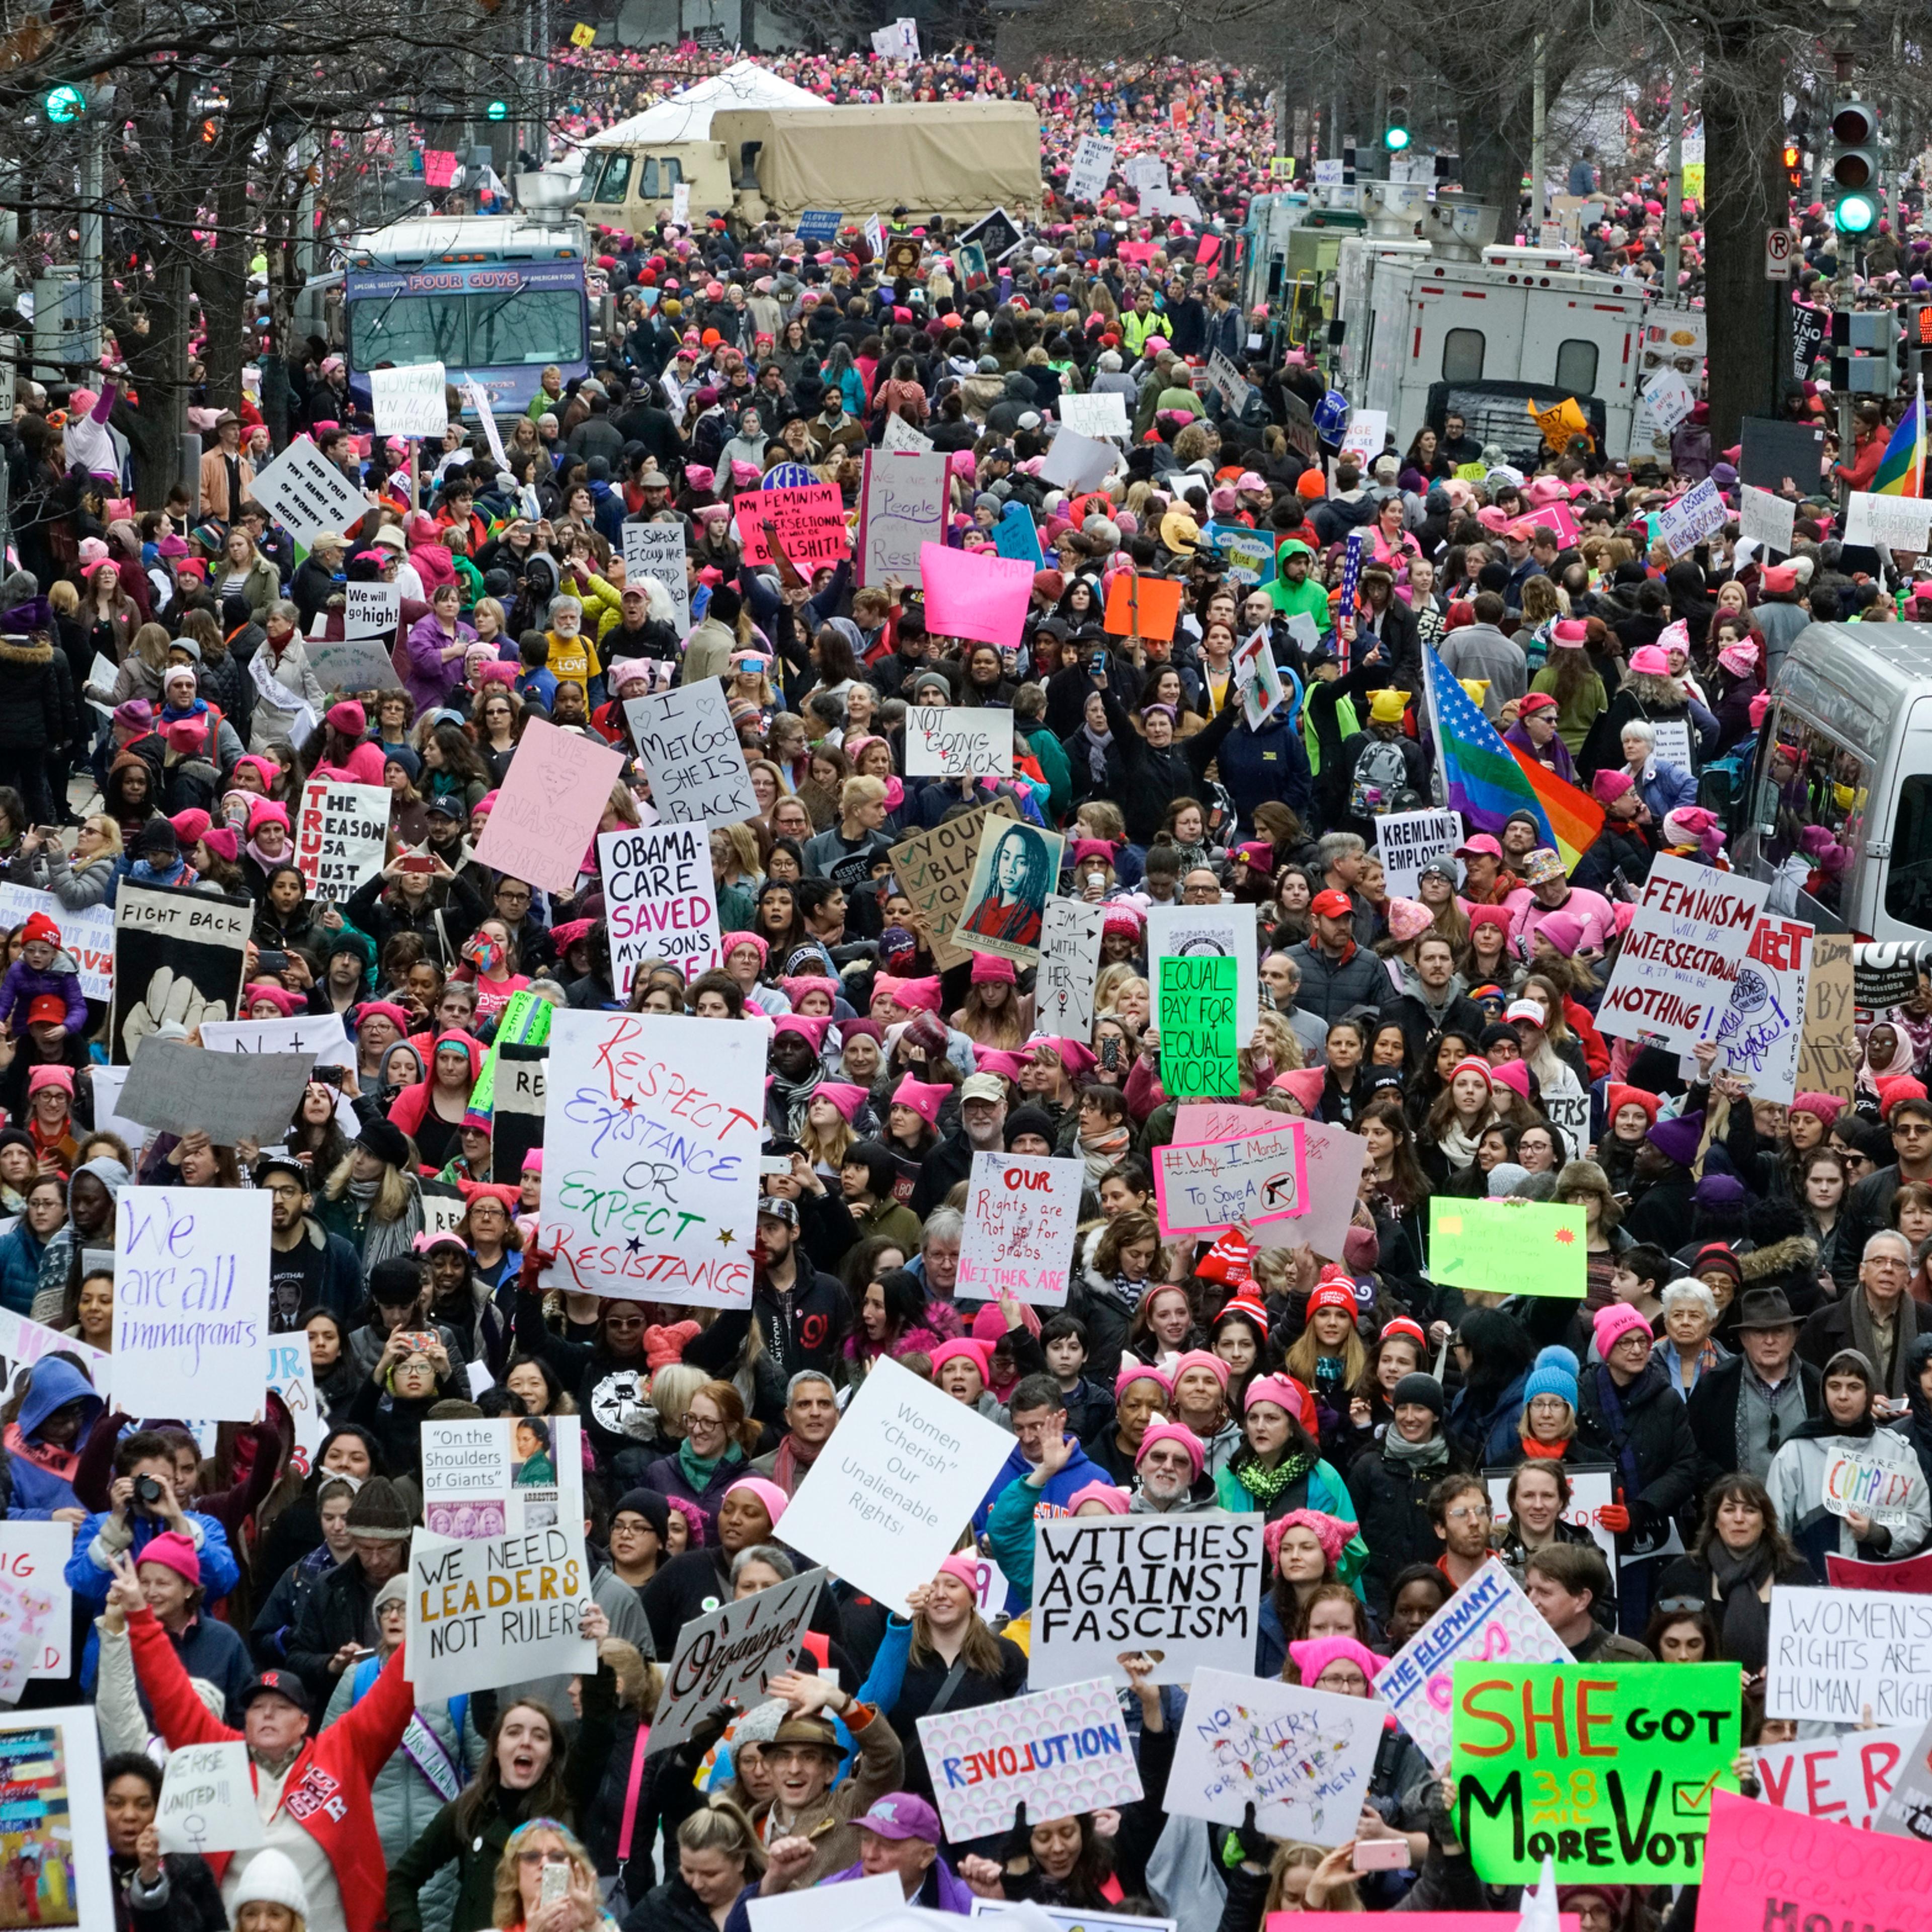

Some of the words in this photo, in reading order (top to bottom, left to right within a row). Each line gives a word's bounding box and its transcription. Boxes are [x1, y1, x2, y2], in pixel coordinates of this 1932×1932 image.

[1084, 149, 1100, 159] WILL
[1087, 140, 1113, 153] TRUMP
[1081, 158, 1092, 166] LIE
[1790, 172, 1801, 187] 4
[410, 273, 462, 291] FOUR
[467, 271, 520, 288] GUYS
[531, 274, 558, 282] AMERICAN
[376, 373, 444, 393] GOVERN
[378, 398, 396, 414] IN
[404, 396, 435, 417] 140
[1072, 394, 1113, 410] BLACK
[1075, 409, 1113, 423] LIVES
[897, 420, 907, 434] WE
[907, 433, 922, 446] ARE
[1072, 420, 1122, 437] MATTER
[1357, 436, 1371, 446] SEE
[306, 460, 326, 479] KEEP
[327, 479, 348, 502] YOUR
[871, 464, 895, 484] We
[286, 461, 305, 481] TINY
[305, 481, 329, 506] HANDS
[329, 507, 345, 523] OFF
[764, 490, 833, 508] FEMINISM
[878, 489, 940, 519] People
[274, 501, 302, 529] RIGHTS
[625, 530, 638, 543] I
[1241, 543, 1266, 553] AMERICA
[627, 549, 639, 562] I
[640, 549, 664, 563] COULD
[349, 589, 368, 602] We
[370, 591, 387, 602] will
[348, 608, 361, 621] go
[363, 607, 398, 627] high!
[558, 658, 588, 672] LOVE
[655, 693, 684, 722] I
[909, 708, 951, 732] NOT
[641, 733, 688, 767] MET
[926, 732, 990, 752] GOING
[662, 768, 703, 795] SHE
[704, 754, 739, 780] IS
[941, 753, 1005, 774] BACK
[307, 786, 357, 813] THE
[669, 789, 752, 825] BLACK
[304, 813, 385, 841] REASON
[300, 833, 347, 858] USA
[612, 831, 703, 868] OBAMA-
[298, 856, 360, 881] MUST
[609, 862, 698, 902] CARE
[1698, 867, 1725, 887] MY
[612, 895, 711, 939] SAVED
[1642, 875, 1758, 932] FEMINISM
[121, 905, 183, 923] FIGHT
[189, 910, 240, 931] BACK
[1057, 910, 1078, 927] I'M
[1671, 917, 1698, 938] WILL
[1705, 927, 1725, 944] BE
[617, 941, 647, 962] MY
[658, 929, 711, 957] SON'S
[967, 932, 975, 941] WE
[982, 936, 997, 946] THE
[999, 940, 1030, 955] PEOPLE
[1050, 939, 1077, 957] WITH
[1622, 928, 1741, 983] INTERSECTIONAL
[1047, 966, 1073, 989] HER
[1162, 961, 1233, 992] EQUAL
[1637, 963, 1654, 979] OR
[1656, 966, 1668, 978] IT
[1674, 970, 1694, 985] WILL
[1696, 975, 1712, 989] BE
[513, 992, 531, 1002] FOR
[1162, 996, 1191, 1024] PAY
[1200, 997, 1234, 1026] FOR
[1796, 976, 1805, 1026] HANDS
[1815, 981, 1850, 1022] BY
[1163, 1030, 1232, 1058] EQUAL
[1789, 1033, 1799, 1064] OFF
[592, 1016, 759, 1141] RESPECT
[1165, 1060, 1238, 1095] WORK
[564, 1087, 742, 1182] EXISTANCE
[1224, 1143, 1243, 1165] I
[622, 1160, 679, 1204] OR
[1003, 1168, 1054, 1193] OUR
[1185, 1186, 1206, 1205] To
[1213, 1184, 1244, 1202] Save
[1245, 1179, 1257, 1197] A
[558, 1169, 707, 1242] EXPECT
[976, 1188, 1027, 1220] Rights
[1040, 1204, 1063, 1217] are
[123, 1195, 194, 1259] We
[982, 1219, 1005, 1237] not
[1036, 1219, 1059, 1240] for
[545, 1222, 752, 1297] RESISTANCE
[120, 1266, 176, 1309] are
[181, 1254, 236, 1312] all
[957, 1258, 1031, 1289] NEITHER
[1035, 1269, 1067, 1292] ARE
[120, 1310, 258, 1378] immigrants
[470, 1430, 493, 1444] the
[897, 1402, 961, 1454] Women
[425, 1451, 501, 1467] Shoulders
[887, 1457, 921, 1485] Our
[1841, 1452, 1862, 1463] WE
[1869, 1458, 1897, 1471] ARE
[426, 1473, 444, 1487] of
[840, 1456, 939, 1527] Unalienable
[1828, 1460, 1914, 1506] COMPLEX
[524, 1491, 558, 1502] ARRESTED
[1826, 1498, 1842, 1511] AND
[848, 1491, 906, 1537] Rights!
[418, 1548, 463, 1586] WE
[487, 1530, 568, 1571] NEED
[1041, 1526, 1255, 1565] WITCHES
[421, 1559, 580, 1623] LEADERS
[1038, 1562, 1258, 1608] AGAINST
[1041, 1607, 1248, 1644] FASCISM
[1788, 1599, 1932, 1639] WOMEN'S
[431, 1615, 487, 1659] NOT
[1381, 1658, 1419, 1700] THE
[1412, 1575, 1501, 1666] ELEPHANT
[1779, 1635, 1869, 1670] RIGHTS
[1882, 1643, 1932, 1674] ARE
[1778, 1676, 1861, 1715] HUMAN
[1197, 1708, 1231, 1743] NO
[1459, 1675, 1619, 1760] SHE
[1625, 1708, 1732, 1744] GOT
[190, 1750, 227, 1773] RISE
[1204, 1774, 1234, 1802] FOR
[1257, 1750, 1328, 1799] WHITE
[1315, 1767, 1356, 1802] MEN
[1530, 1769, 1598, 1810] 3.8
[1459, 1770, 1615, 1867] MORE
[1532, 1809, 1592, 1825] MIL
